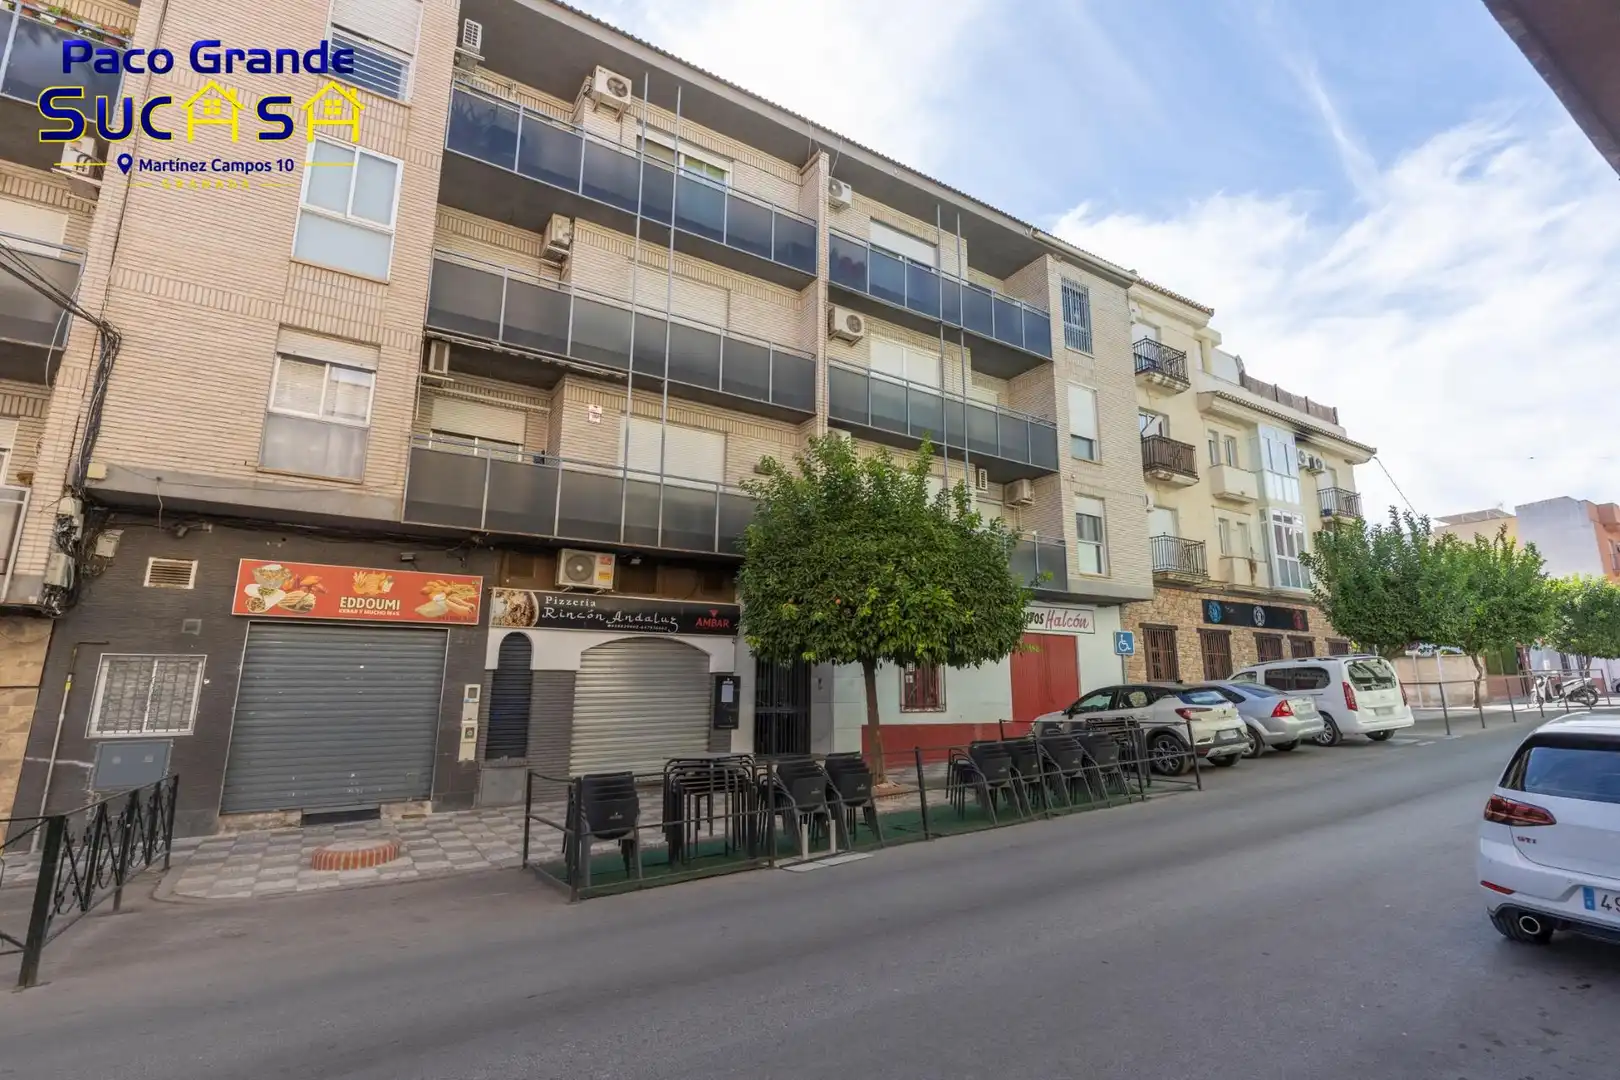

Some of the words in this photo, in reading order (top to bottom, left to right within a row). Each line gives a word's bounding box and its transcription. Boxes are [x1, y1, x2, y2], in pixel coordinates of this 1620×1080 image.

[339, 596, 401, 611] EDDOUMI
[545, 595, 596, 607] Pizzeria
[541, 606, 605, 622] Rincón
[606, 610, 679, 634] Andaluz
[695, 617, 730, 628] AMBAR
[1045, 609, 1089, 629] Halcón
[1517, 836, 1537, 844] GTI
